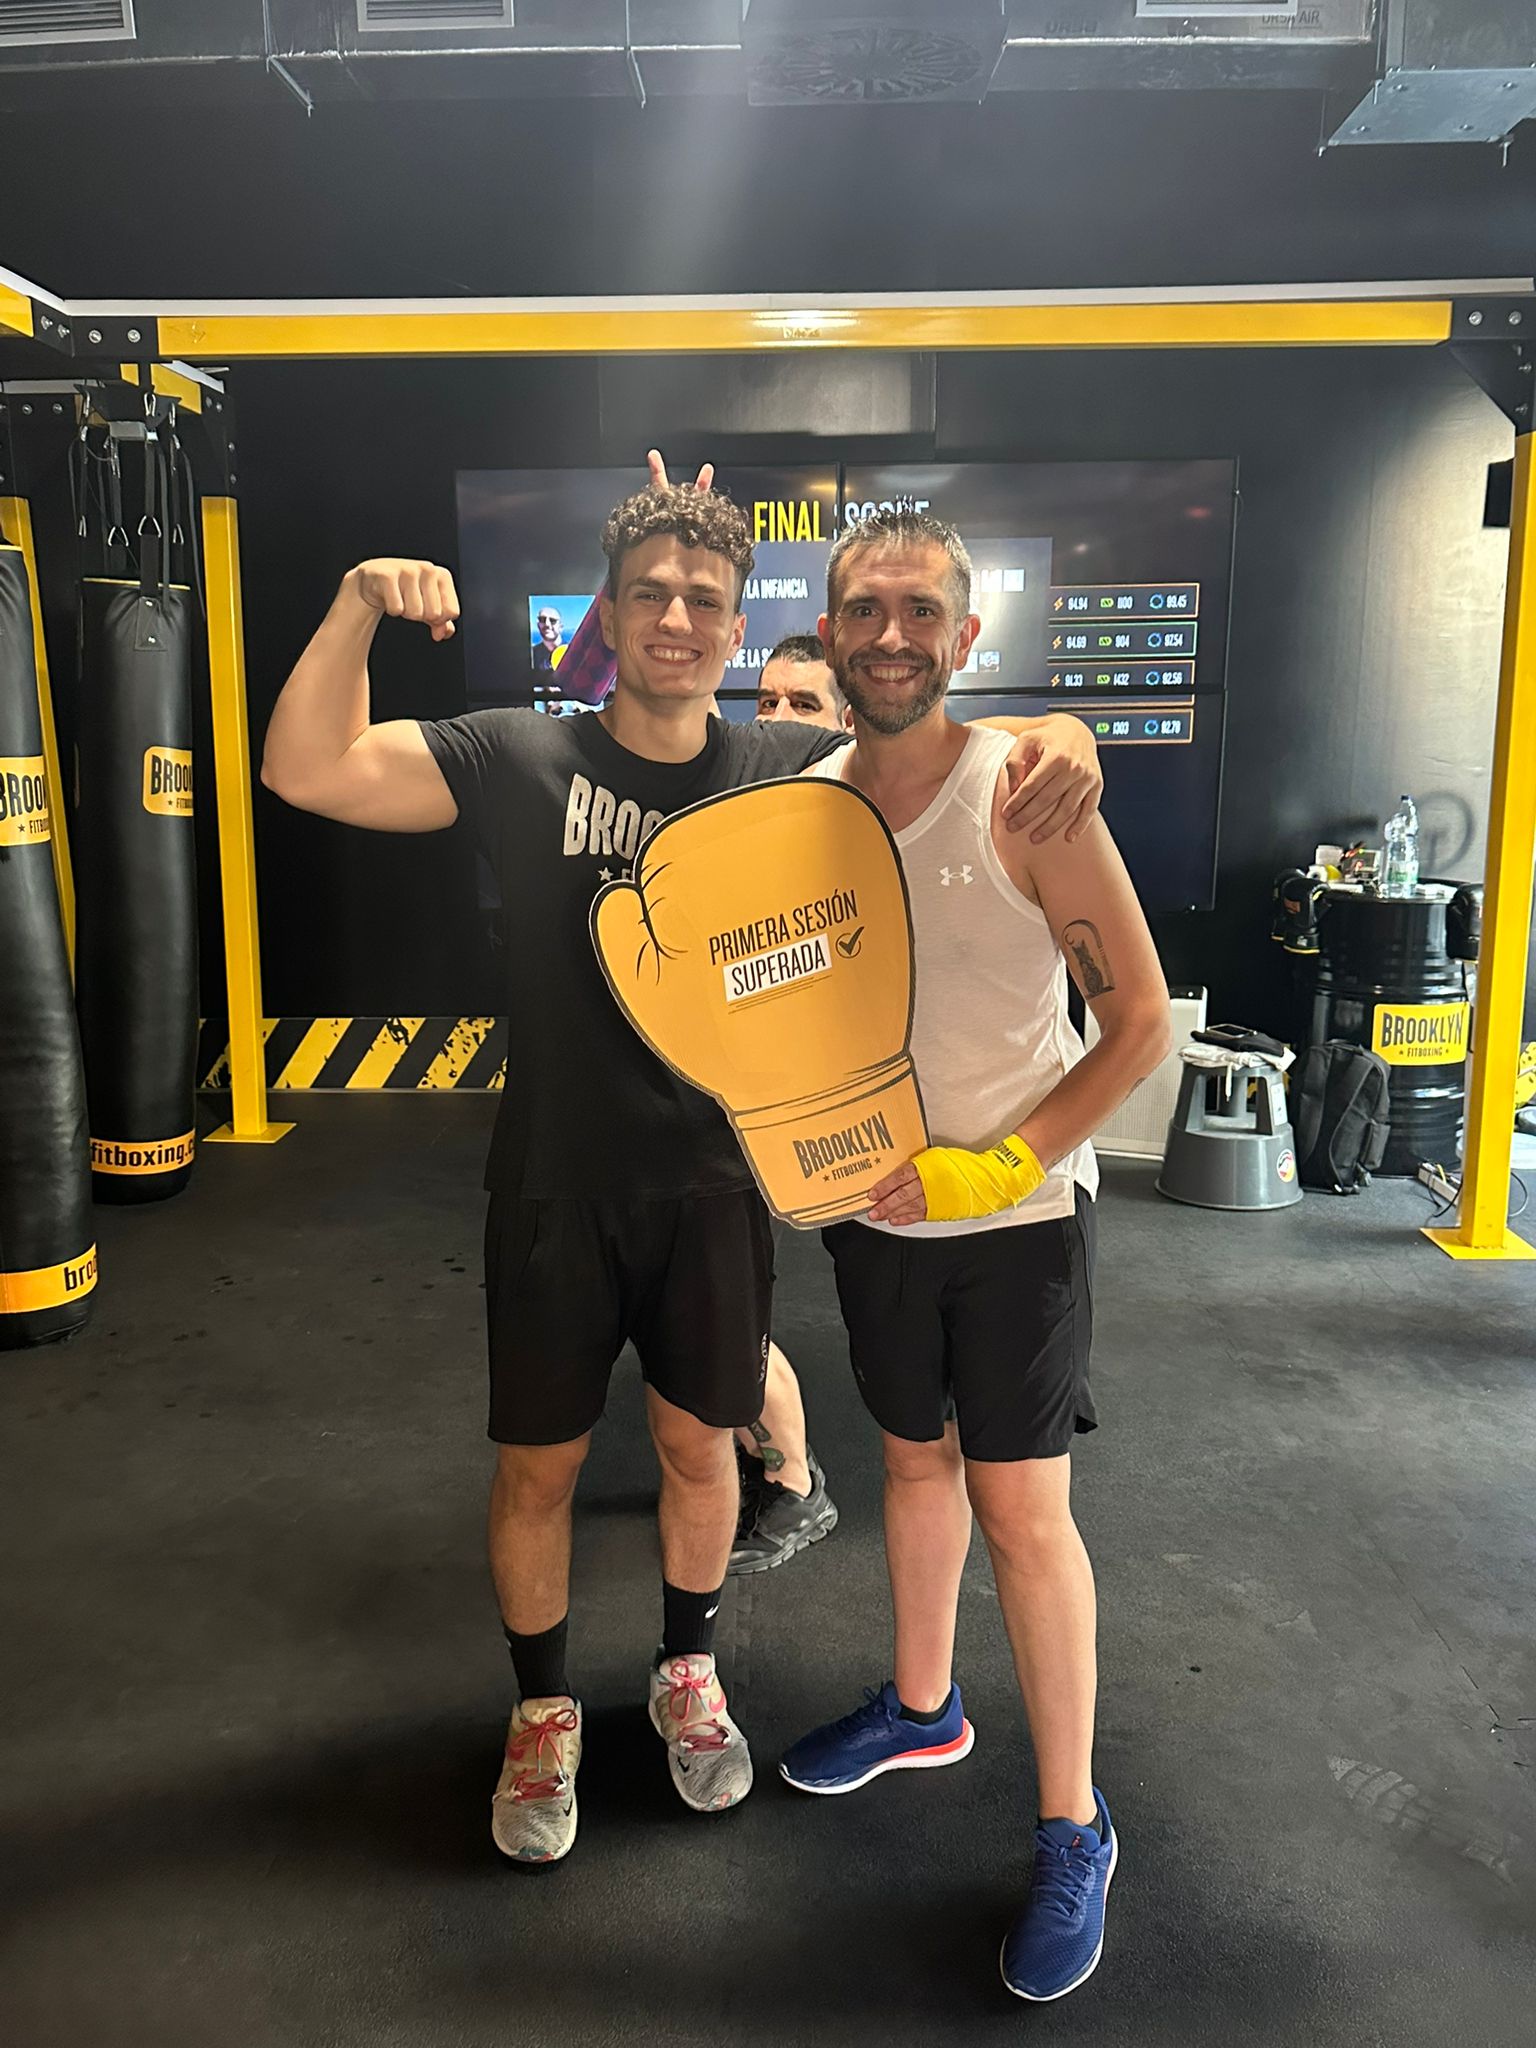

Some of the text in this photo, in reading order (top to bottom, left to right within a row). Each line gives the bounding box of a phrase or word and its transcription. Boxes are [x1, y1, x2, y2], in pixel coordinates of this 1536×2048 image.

[1298, 10, 1320, 24] AIR
[753, 500, 827, 543] FINAL
[761, 577, 808, 599] INFANCIA
[709, 888, 858, 966] PRIMERA SESIÓN
[731, 939, 826, 996] SUPERADA
[1381, 1009, 1464, 1048] BROOKLYN
[1407, 1046, 1443, 1058] FITBOXING
[792, 1110, 894, 1179] BROOKLYN
[831, 1158, 872, 1181] FITBOXING
